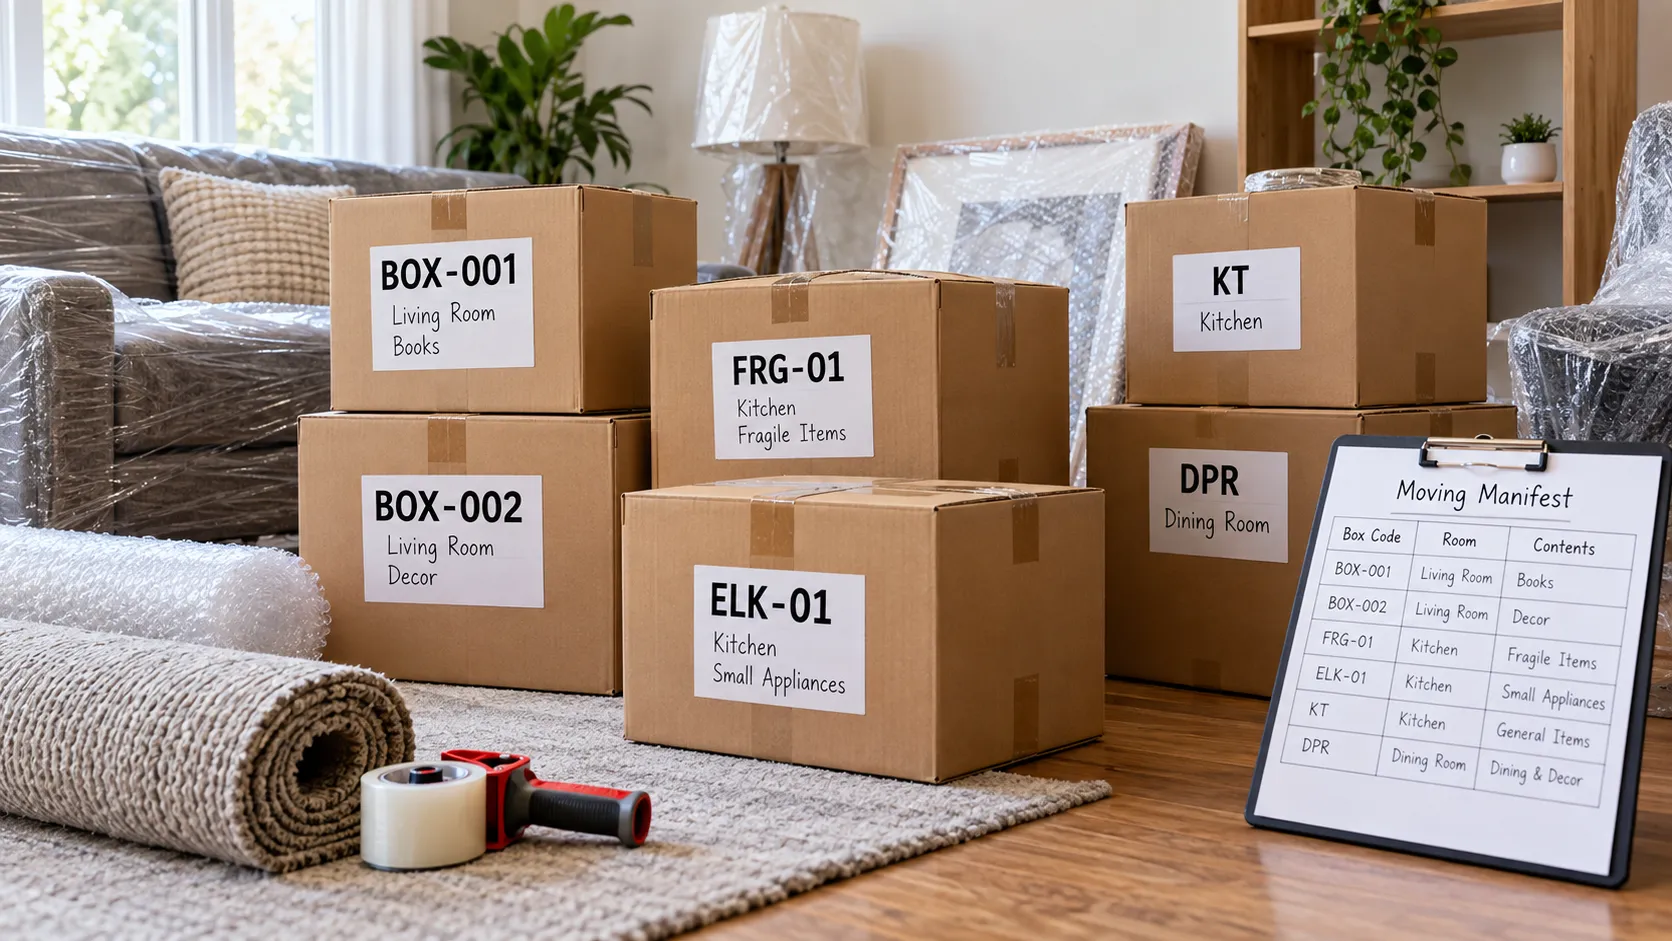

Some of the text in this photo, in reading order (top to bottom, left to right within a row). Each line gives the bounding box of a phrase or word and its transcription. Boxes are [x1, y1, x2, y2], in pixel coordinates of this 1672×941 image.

[381, 252, 516, 291] BOX-001
[1213, 264, 1250, 296] KT
[392, 301, 496, 333] Living Room
[1200, 309, 1263, 333] Kitchen
[393, 334, 440, 357] Books
[732, 350, 845, 386] FRG-01
[737, 396, 796, 418] Kitchen
[738, 422, 847, 451] Fragile Items
[1180, 462, 1240, 497] DPR
[375, 489, 523, 524] BOX-002
[1396, 479, 1574, 512] Moving Manifest
[1164, 507, 1270, 540] Dining Room
[1342, 526, 1402, 544] Box Code
[387, 534, 494, 565] Living Room
[1442, 531, 1477, 548] Room
[1533, 537, 1596, 556] Contents
[387, 564, 438, 586] Decor
[1334, 561, 1391, 578] BOX-001
[1420, 566, 1493, 588] Living Room
[1516, 572, 1554, 590] Books
[711, 581, 832, 625] ELK-01
[1327, 595, 1387, 614] BOX-002
[1415, 601, 1489, 624] Living Room
[1512, 608, 1551, 626] Decor
[713, 630, 777, 657] Kitchen
[1322, 630, 1373, 649] FRG-01
[1411, 638, 1458, 657] Kitchen
[1507, 646, 1597, 671] Fragile Items
[713, 662, 846, 698] Small Appliances
[1315, 665, 1367, 685] ELK-01
[1405, 673, 1452, 693] Kitchen
[1308, 701, 1330, 717] KT
[1501, 683, 1606, 712] Small Appliances
[1398, 711, 1446, 731] Kitchen
[1301, 737, 1330, 755] DPR
[1496, 721, 1590, 749] General Items
[1391, 747, 1467, 773] Dining Room
[1490, 759, 1584, 787] Dining & Decor
